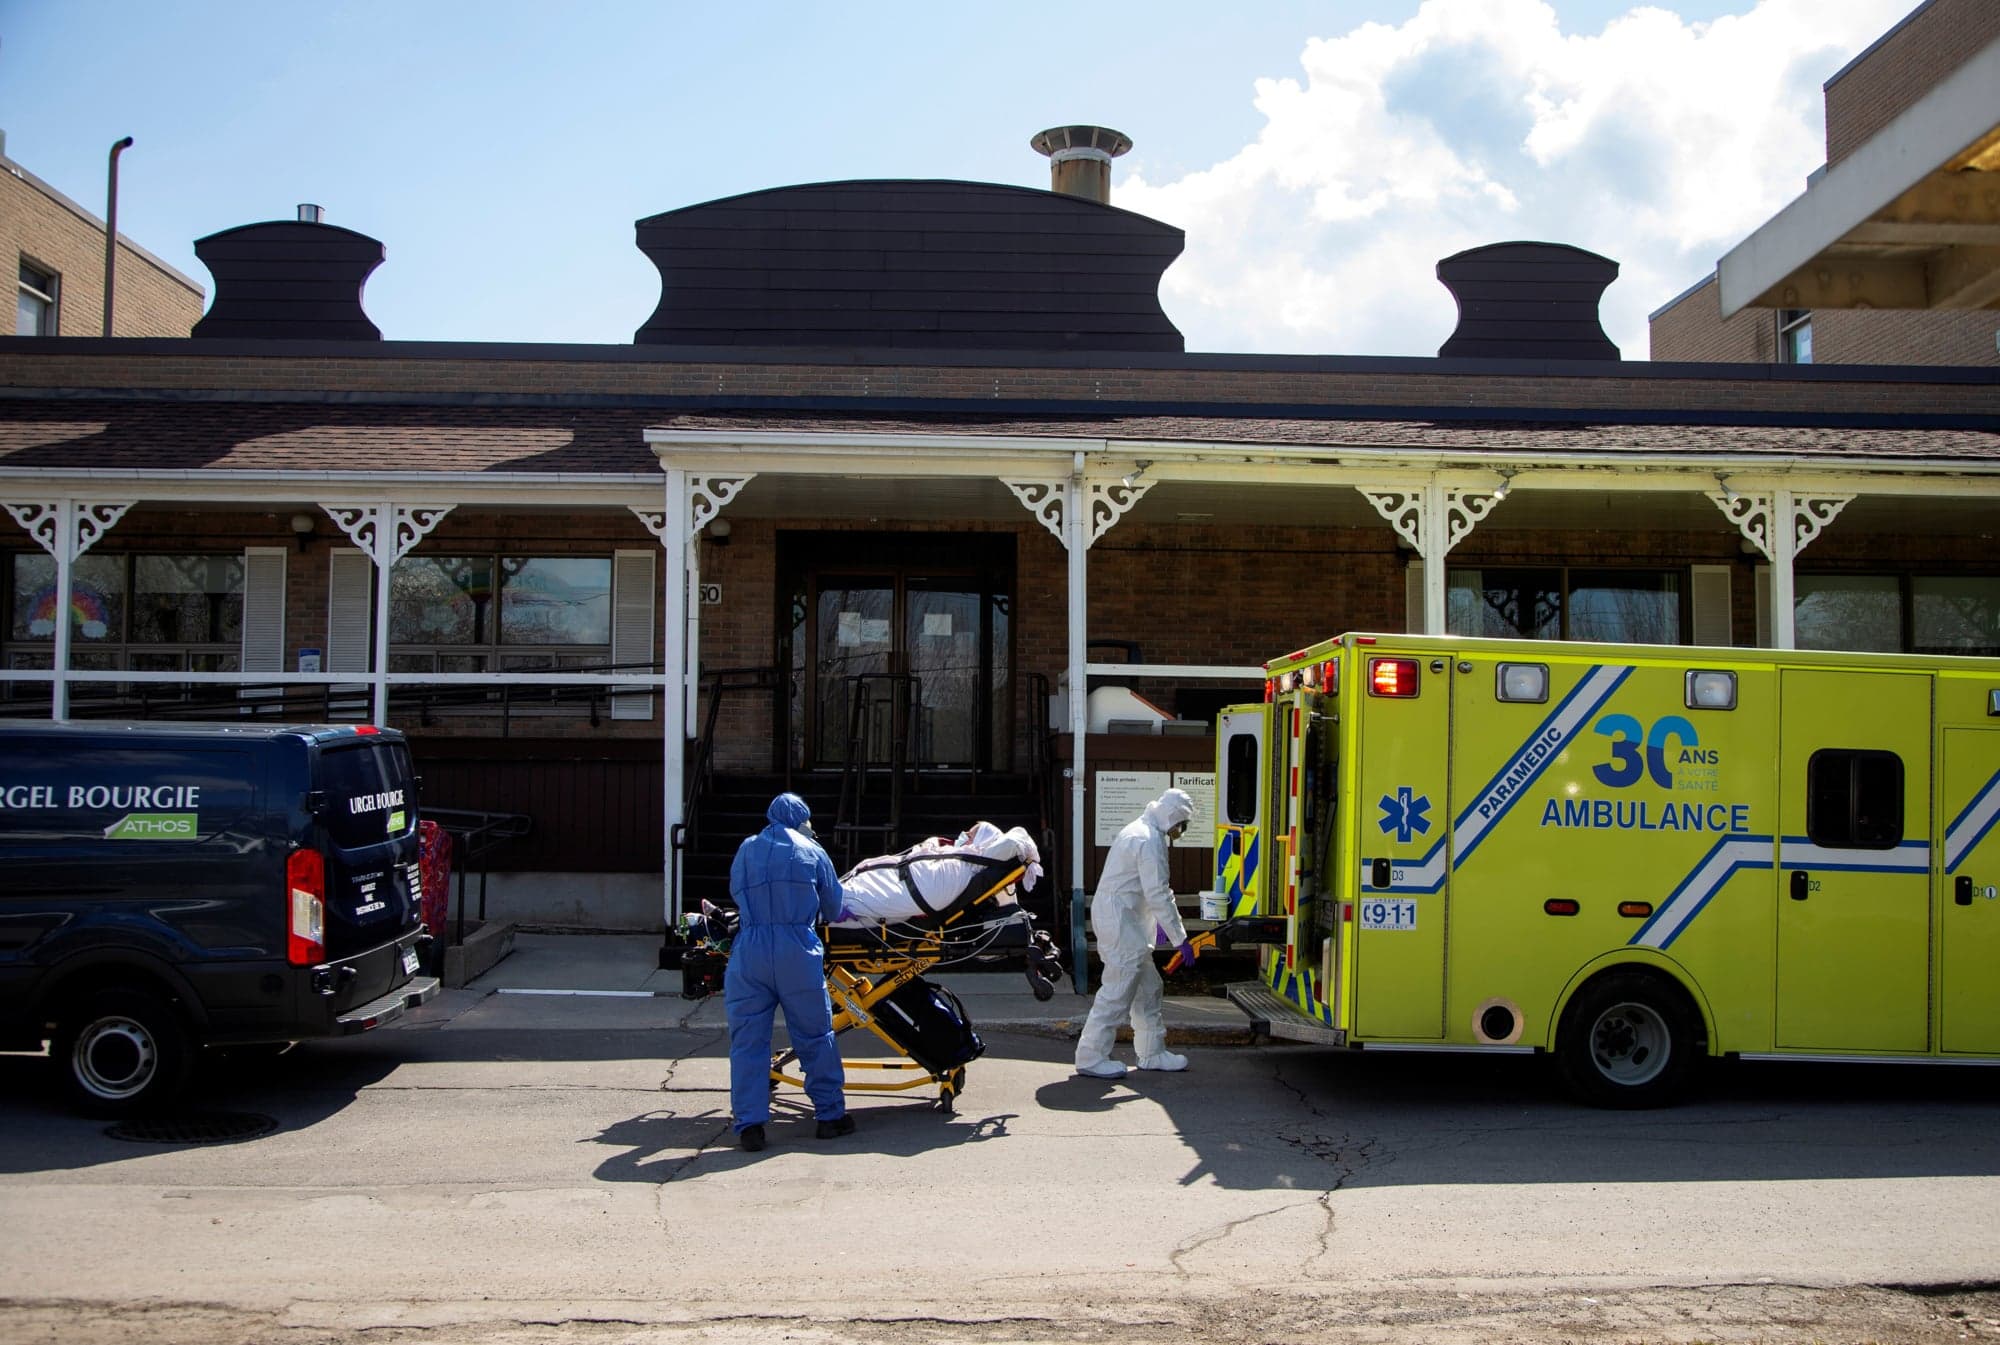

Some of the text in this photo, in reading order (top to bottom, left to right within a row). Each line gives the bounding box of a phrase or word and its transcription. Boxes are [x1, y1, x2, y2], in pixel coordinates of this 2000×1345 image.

[1592, 713, 1699, 790] 30
[1678, 750, 1720, 764] ANS
[1478, 726, 1563, 820] PARAMÉDIC
[1687, 768, 1719, 777] VOTRE
[1677, 779, 1719, 791] SANTÉ
[68, 786, 200, 809] BOURGIE
[350, 795, 376, 814] URGEL
[1541, 798, 1750, 833] AMBULANCE
[123, 821, 191, 833] ATHOS
[1392, 870, 1404, 881] D3
[1808, 880, 1821, 892] D2
[1973, 886, 1984, 897] D1
[1373, 904, 1415, 925] 9-1-1
